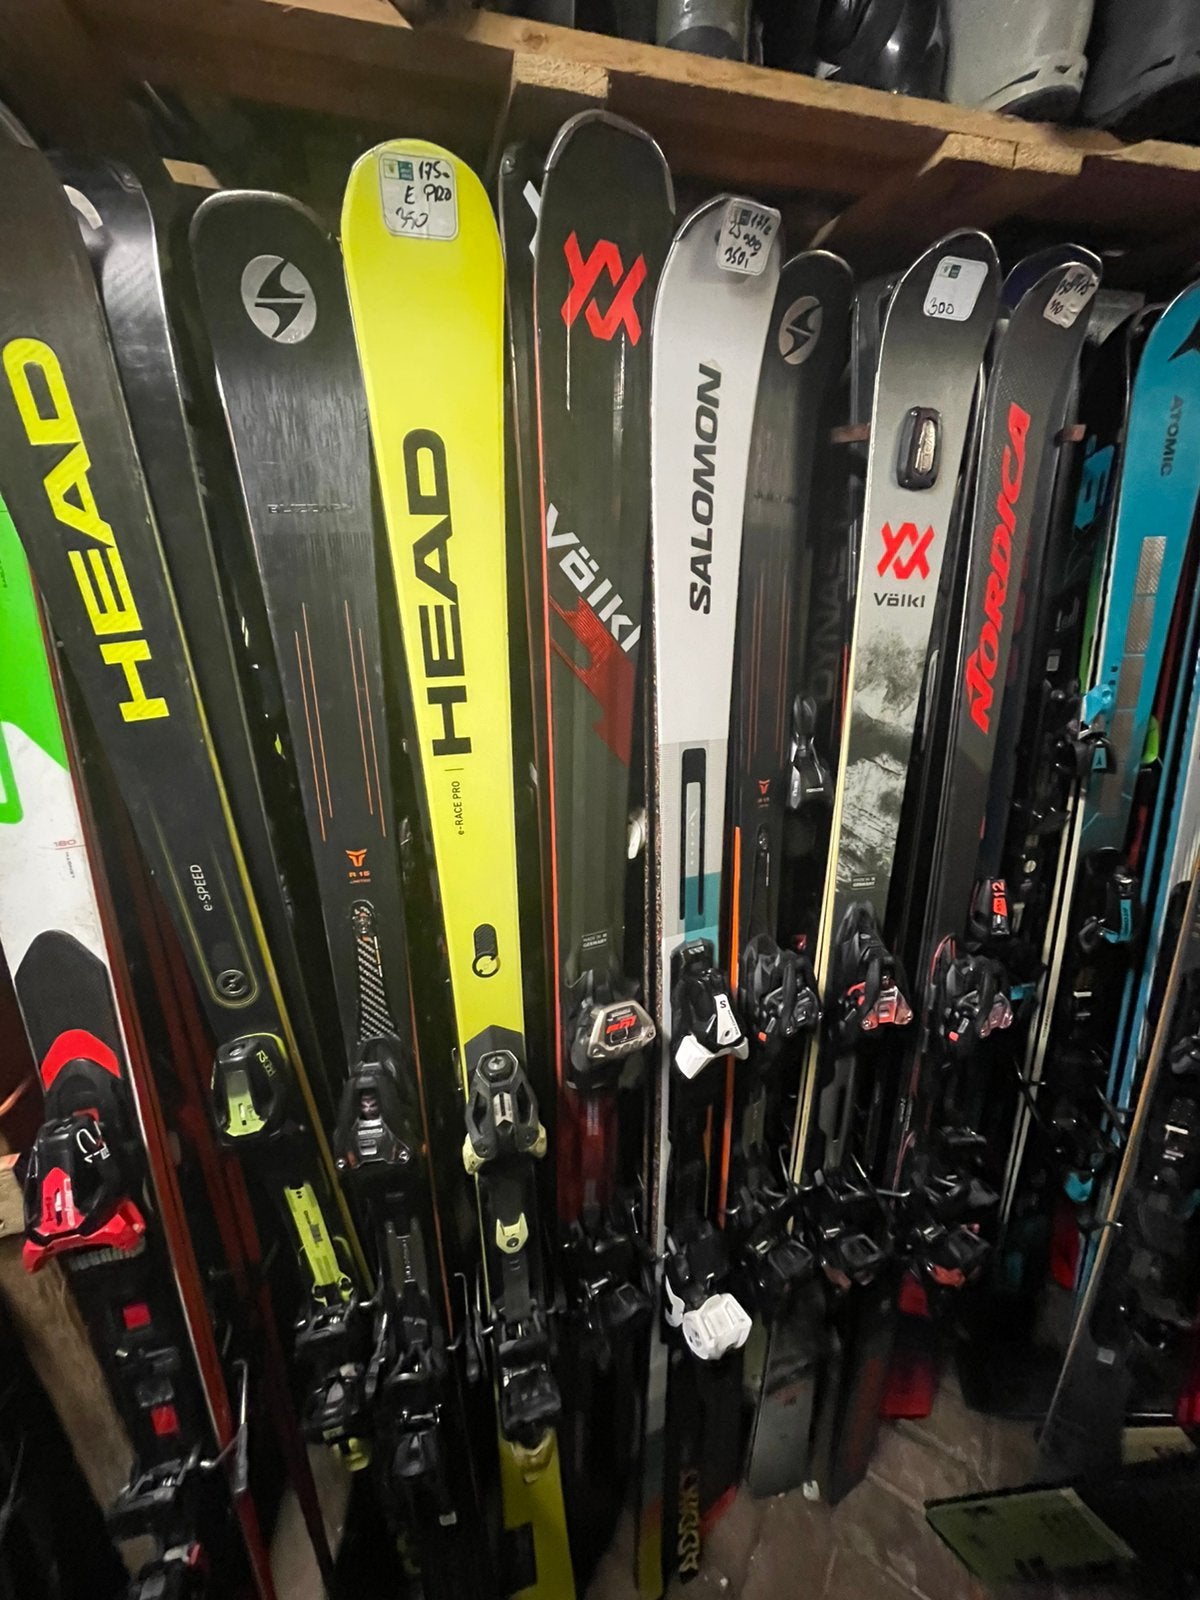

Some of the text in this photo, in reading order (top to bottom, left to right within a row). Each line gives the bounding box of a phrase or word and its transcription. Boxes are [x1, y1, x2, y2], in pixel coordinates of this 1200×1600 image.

[404, 185, 415, 205] E
[928, 297, 955, 316] 300
[1160, 394, 1185, 477] ATOMIC
[2, 338, 170, 722] HEAD
[689, 362, 722, 615] SALOMON
[402, 429, 472, 756] HEAD
[546, 502, 642, 654] Völkl
[873, 592, 926, 608] Völkl
[965, 402, 1031, 734] NORDICA
[451, 781, 465, 836] e-RACE PRO
[190, 864, 213, 911] e-SPEED
